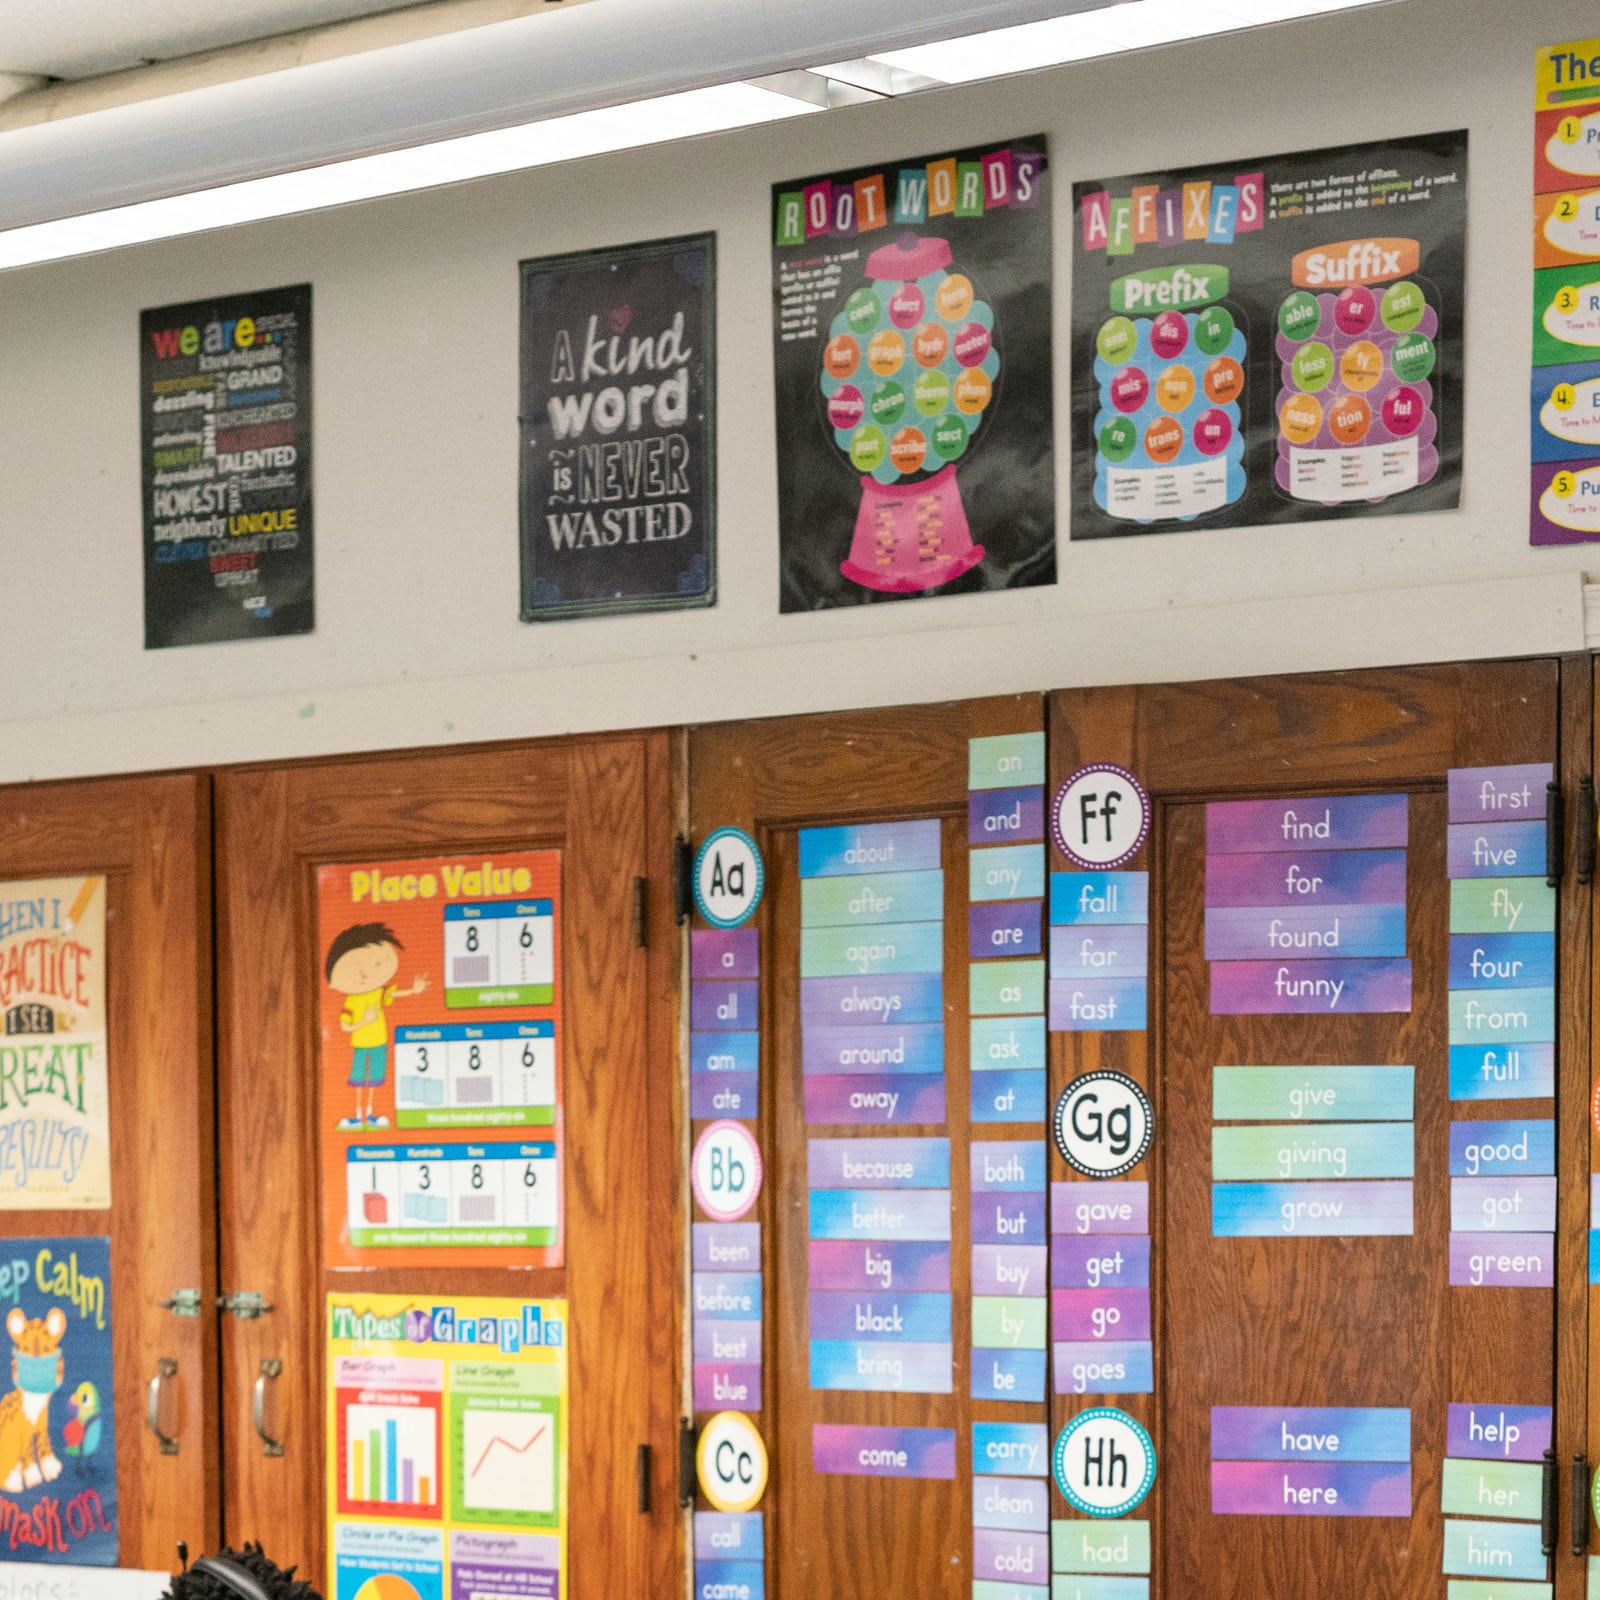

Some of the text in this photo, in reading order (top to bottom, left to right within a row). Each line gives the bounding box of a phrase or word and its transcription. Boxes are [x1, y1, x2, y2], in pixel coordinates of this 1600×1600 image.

[1566, 124, 1574, 137] 1.
[785, 162, 1032, 238] ROOT WORDS
[1089, 182, 1257, 245] AFFIXES
[1561, 202, 1572, 216] 2.
[1306, 242, 1400, 284] Suffix
[1125, 269, 1209, 310] Prefix
[1561, 293, 1572, 307] 3.
[1159, 324, 1178, 338] dis
[1285, 305, 1313, 326] able
[153, 326, 199, 359] we
[551, 311, 691, 383] A kind
[1214, 368, 1235, 387] pre
[547, 367, 689, 440] word
[1557, 391, 1570, 404] 4.
[1148, 429, 1180, 447] trans
[216, 446, 297, 474] TALENTED
[553, 434, 690, 505] is NEVER
[1559, 478, 1570, 491] 5.
[230, 509, 297, 536] UNIQUE
[1569, 504, 1588, 514] Time
[547, 502, 691, 551] WASTED
[984, 802, 1020, 831] and
[1081, 791, 1122, 843] Ff
[1282, 810, 1330, 840] find
[351, 862, 531, 903] Place Value
[710, 850, 745, 898] Aa
[52, 898, 61, 929] I
[466, 923, 532, 951] 8 6
[1268, 918, 1339, 948] found
[1276, 967, 1344, 1008] funny
[10, 1006, 50, 1033] I SEE
[840, 1038, 904, 1063] around
[850, 1092, 898, 1118] away
[1072, 1093, 1132, 1154] Gg
[1465, 1132, 1527, 1174] good
[371, 1162, 536, 1190] 1 3 8 6
[710, 1147, 745, 1193] Bb
[1282, 1198, 1342, 1232] grow
[866, 1249, 892, 1288] big
[36, 1249, 105, 1330] Calm
[333, 1307, 402, 1351] Types
[433, 1307, 562, 1353] Graphs
[1282, 1422, 1339, 1452] have
[1470, 1412, 1519, 1454] help
[716, 1441, 752, 1484] Cc
[860, 1447, 907, 1467] come
[1085, 1437, 1127, 1488] Hh
[1284, 1476, 1337, 1505] here
